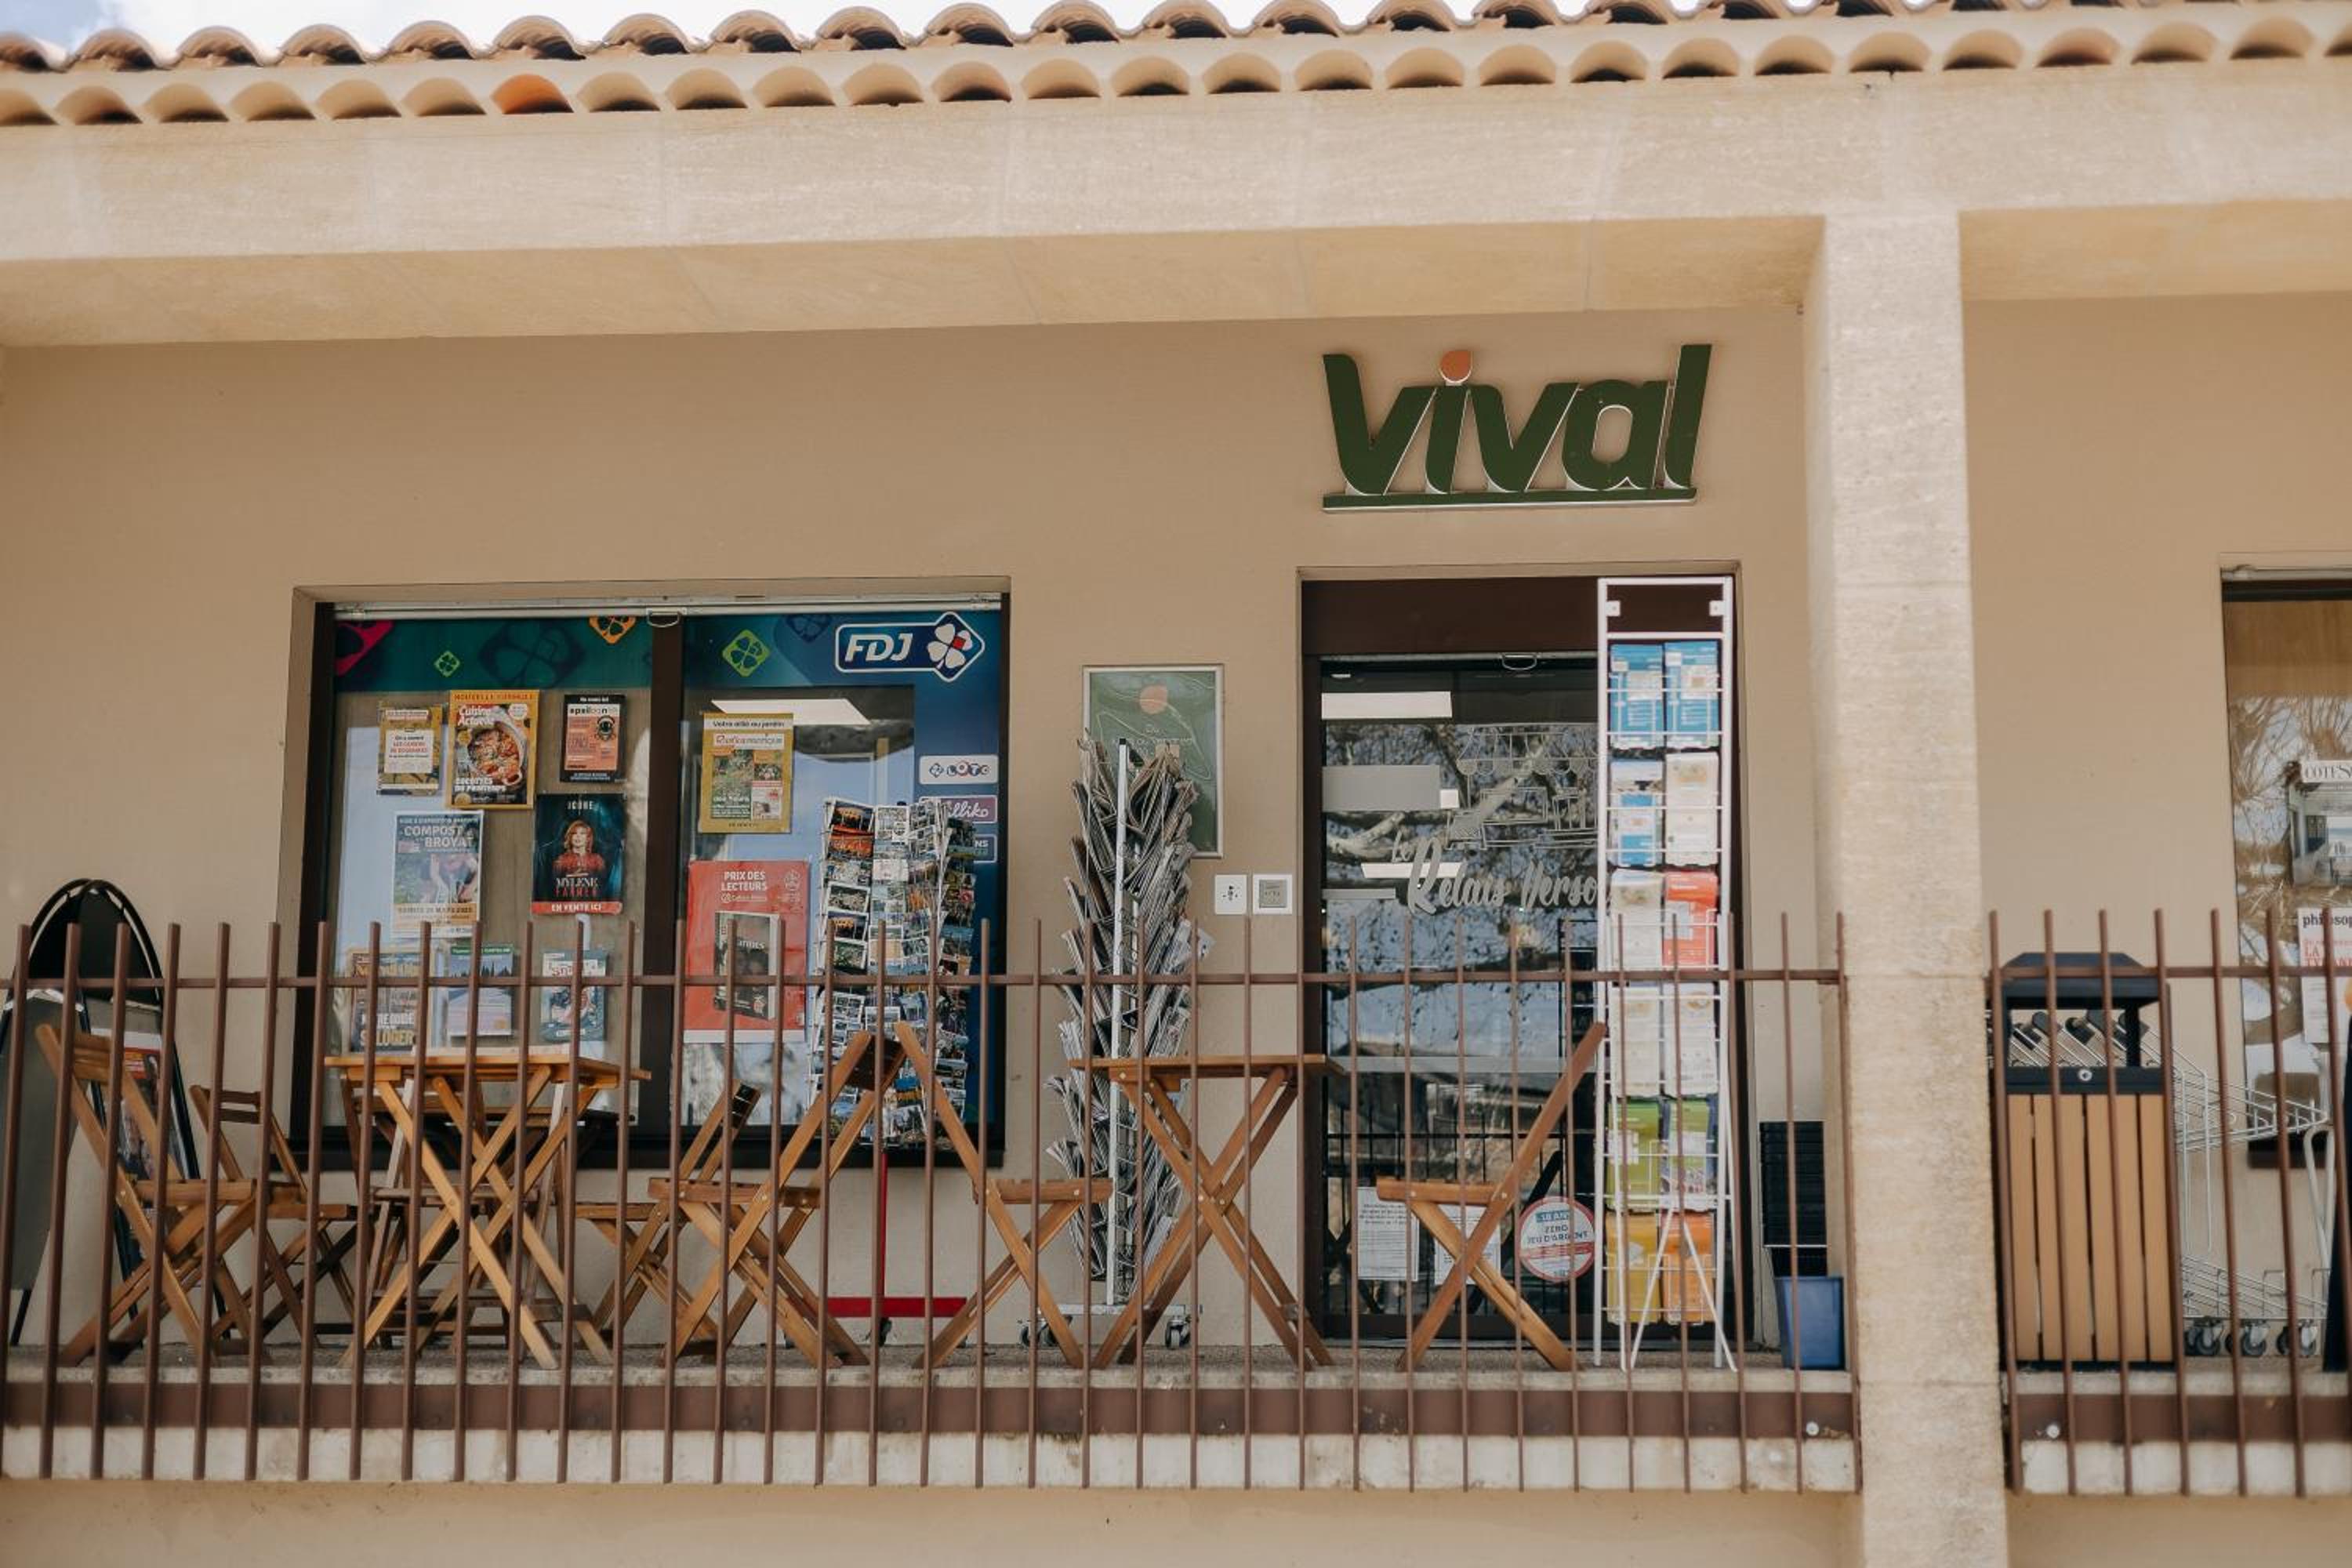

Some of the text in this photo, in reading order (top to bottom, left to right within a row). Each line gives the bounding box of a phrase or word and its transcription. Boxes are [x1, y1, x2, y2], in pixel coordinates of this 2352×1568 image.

[844, 633, 914, 662] FDJ
[949, 800, 989, 818] lliko
[404, 826, 463, 837] COMPOST
[426, 837, 475, 848] BROYAT
[724, 871, 766, 880] PRIX DES
[721, 880, 767, 891] LECTEURS
